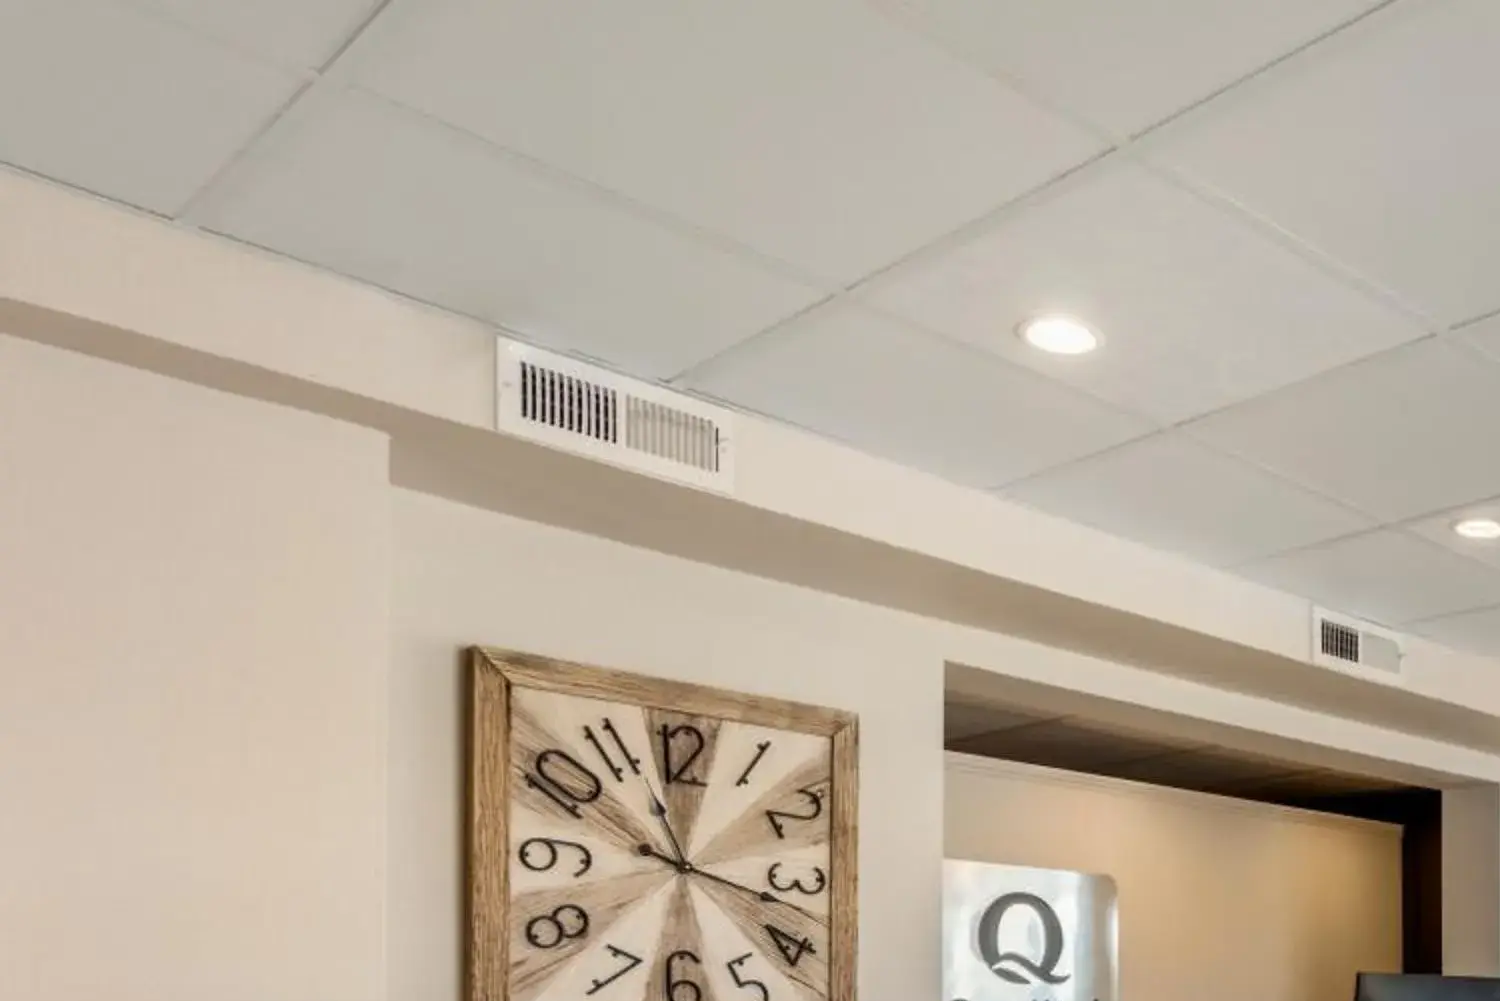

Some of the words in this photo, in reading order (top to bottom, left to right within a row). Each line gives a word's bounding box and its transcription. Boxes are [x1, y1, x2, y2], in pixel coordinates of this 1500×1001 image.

[583, 717, 641, 782] 11
[657, 723, 708, 788] 12
[736, 740, 771, 787] 1
[524, 749, 602, 819] 10
[765, 789, 826, 839] 2
[519, 837, 592, 878] 9
[768, 862, 826, 895] 3
[525, 904, 590, 949] 8
[764, 924, 817, 967] 4
[978, 891, 1071, 984] Q
[586, 944, 643, 995] 7
